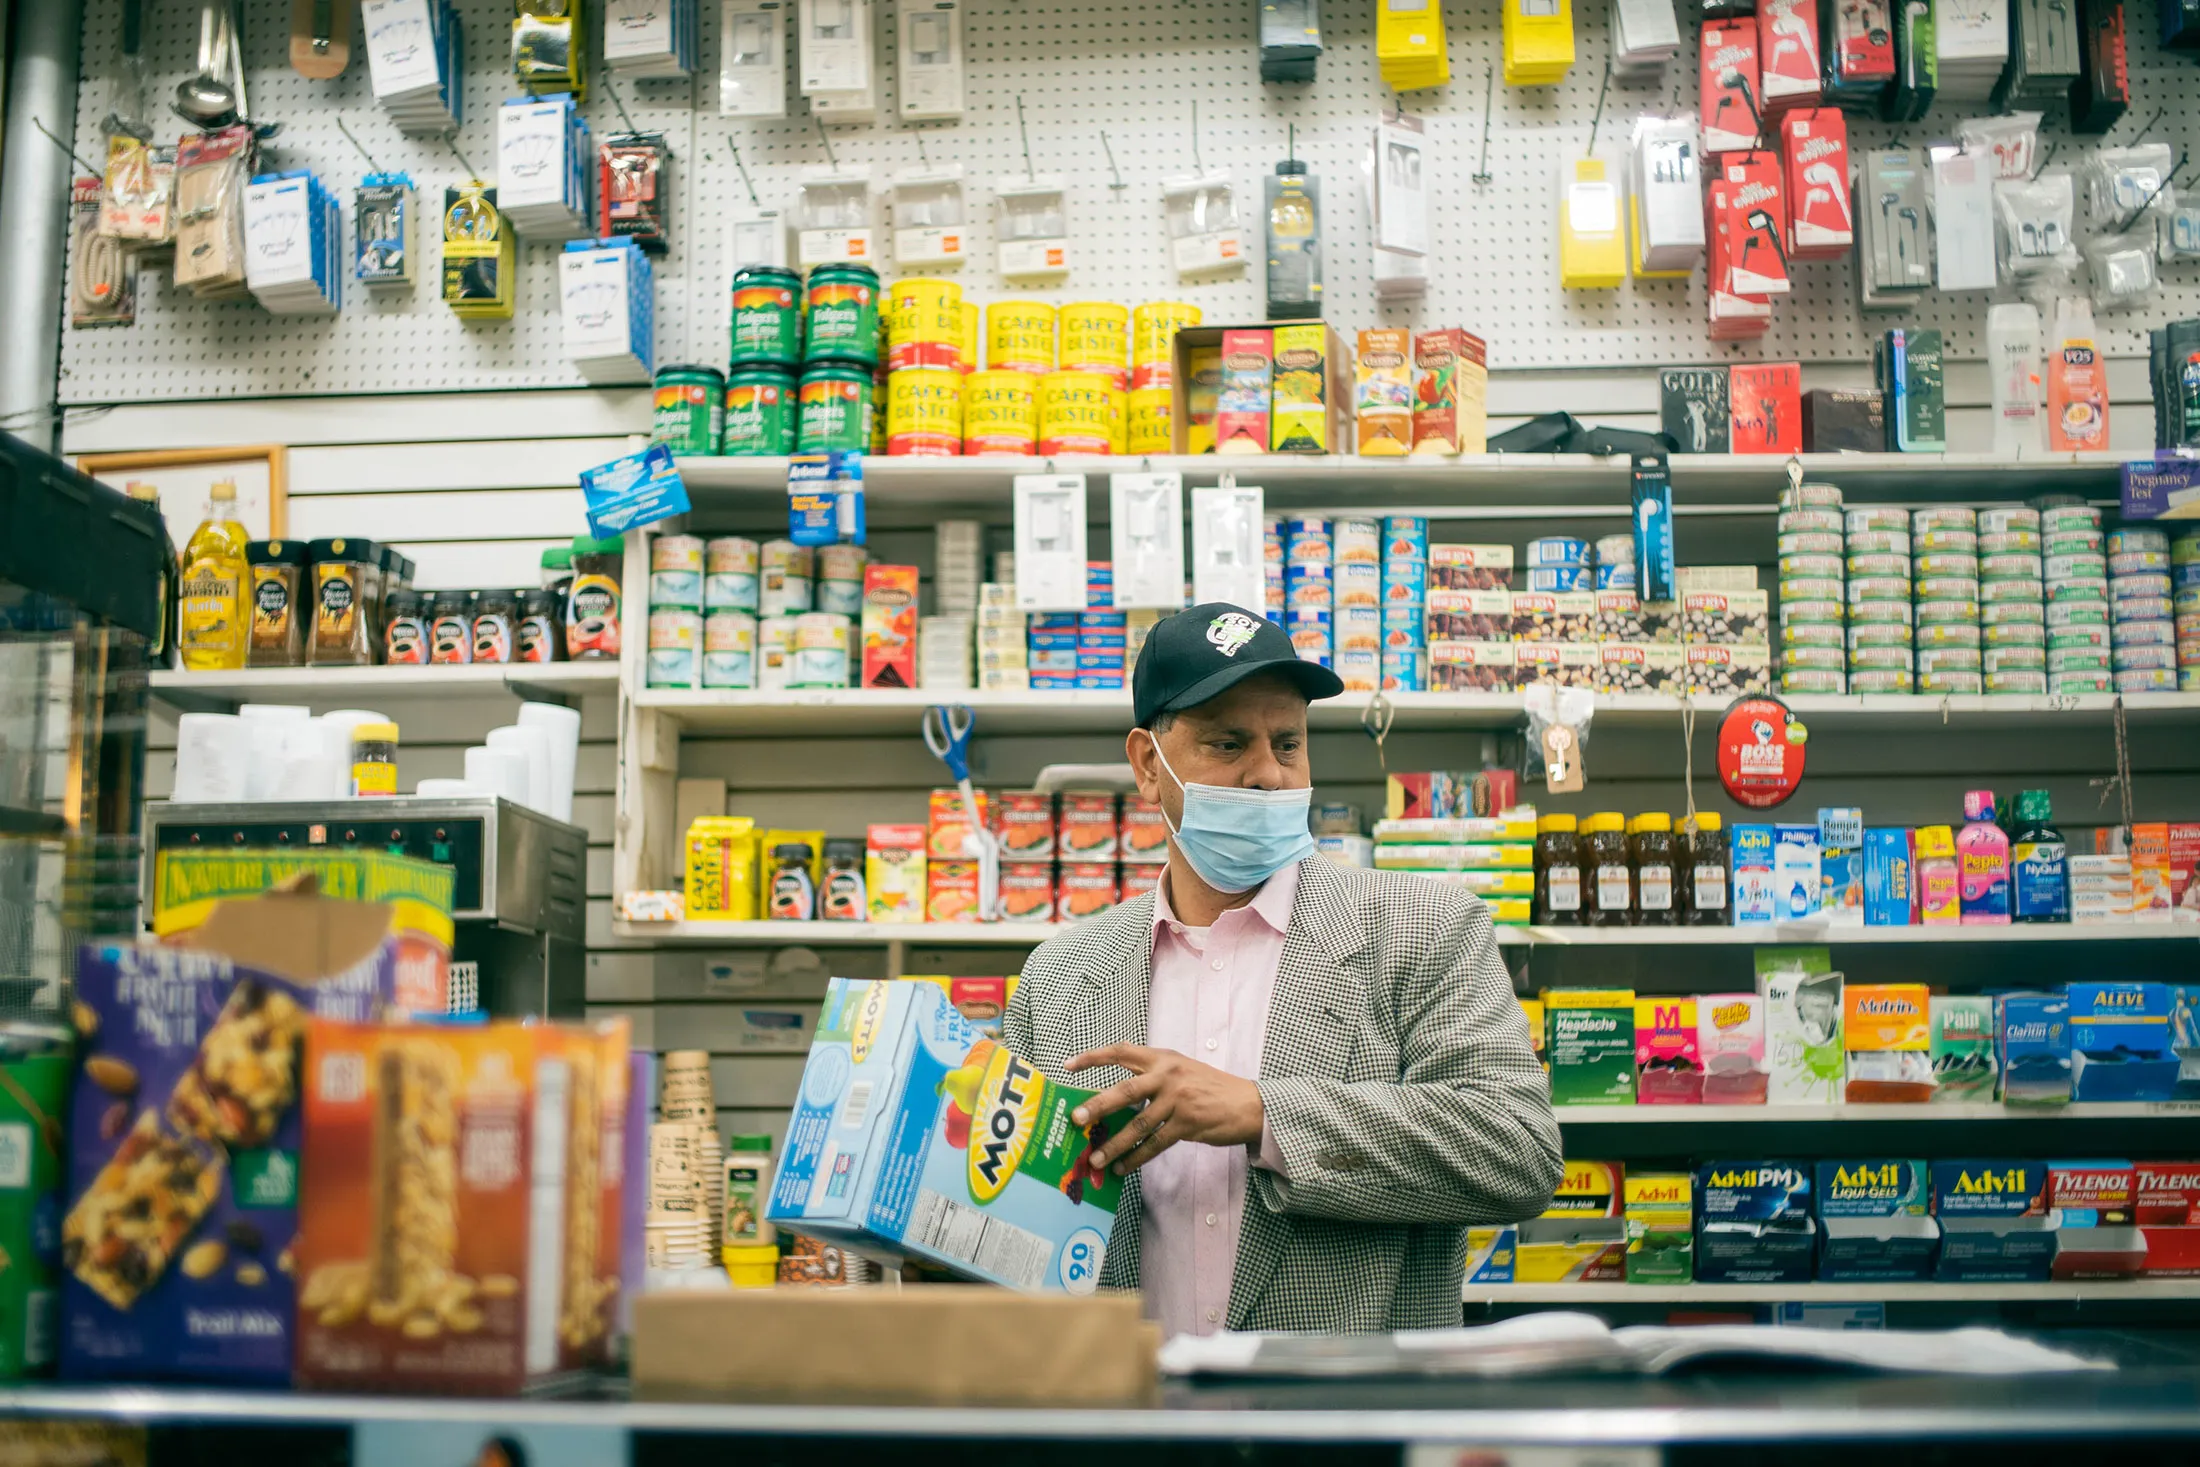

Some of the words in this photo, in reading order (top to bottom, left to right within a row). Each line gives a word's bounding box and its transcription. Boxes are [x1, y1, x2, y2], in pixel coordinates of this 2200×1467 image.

[2129, 472, 2190, 488] Pregnancy
[2129, 486, 2153, 500] Test
[1433, 549, 1474, 563] IBERIA
[1431, 594, 1471, 608] IBERIA
[1515, 595, 1555, 609] IBERIA
[1600, 596, 1640, 609] IBERIA
[1686, 595, 1727, 609] IBERIA
[1433, 647, 1474, 662] IBERIA
[1518, 648, 1559, 662] IBERIA
[1603, 647, 1644, 662] IBERIA
[1689, 647, 1730, 662] IBERIA
[1823, 818, 1859, 831] Rompe
[1823, 831, 1856, 843] Pecho
[1963, 852, 2003, 868] Pepto
[2025, 863, 2062, 877] NyQuil
[169, 859, 263, 899] NATURE
[1856, 997, 1912, 1015] Motrin
[2093, 990, 2145, 1007] ALEVE
[1556, 1016, 1618, 1032] Headache
[1655, 1005, 1681, 1030] M
[1943, 1009, 1980, 1029] Pain
[2006, 1024, 2047, 1039] Claritin
[1043, 1097, 1067, 1160] ASSORTED
[1054, 1116, 1069, 1148] FRUIT
[1562, 1171, 1592, 1191] vil
[1706, 1169, 1757, 1188] Advil
[1757, 1168, 1793, 1187] PM
[1830, 1164, 1899, 1188] Advil
[1951, 1169, 2026, 1194] Advil
[2053, 1171, 2130, 1191] TYLENOL
[1636, 1187, 1680, 1202] Advil
[1069, 1242, 1089, 1283] 90
